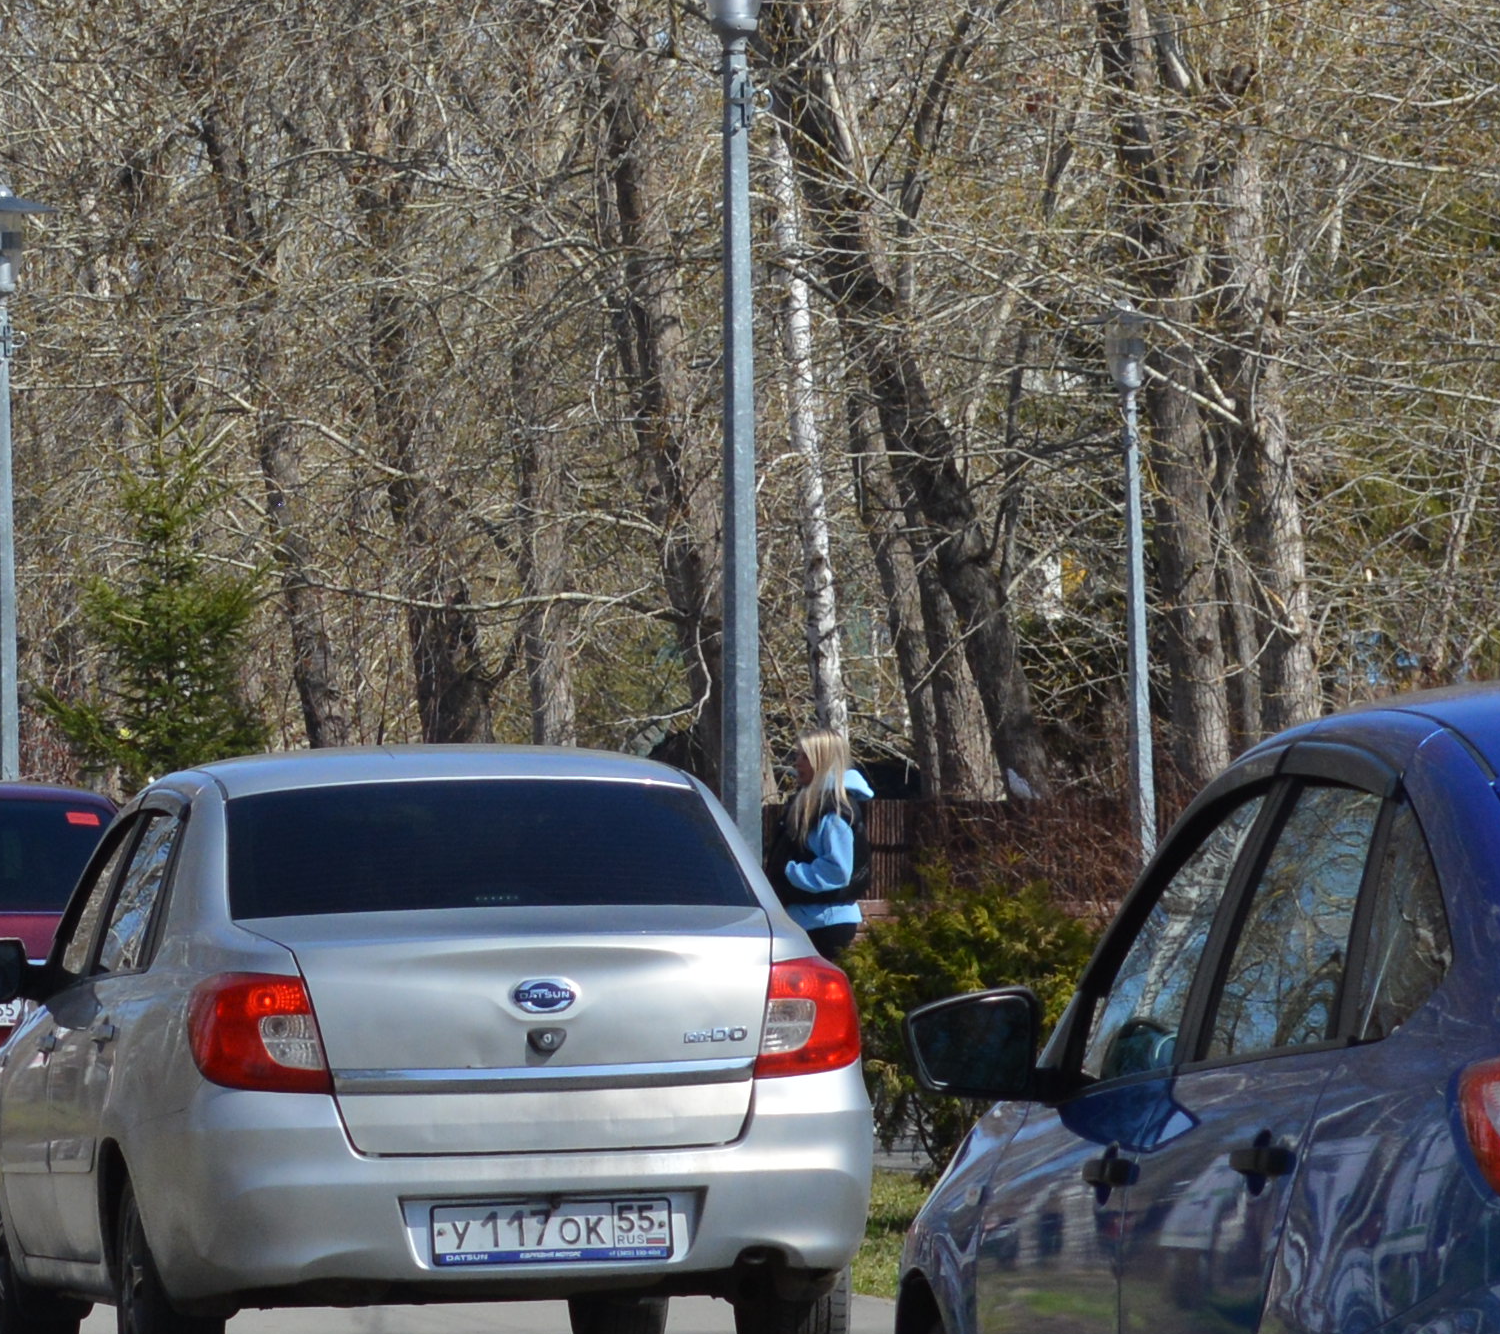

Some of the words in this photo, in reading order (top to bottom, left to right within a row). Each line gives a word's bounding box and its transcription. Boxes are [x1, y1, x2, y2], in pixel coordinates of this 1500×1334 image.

[519, 988, 570, 1000] DATSUN
[616, 1204, 655, 1234] 55
[616, 1232, 646, 1246] RUS
[445, 1252, 489, 1263] DATSUN
